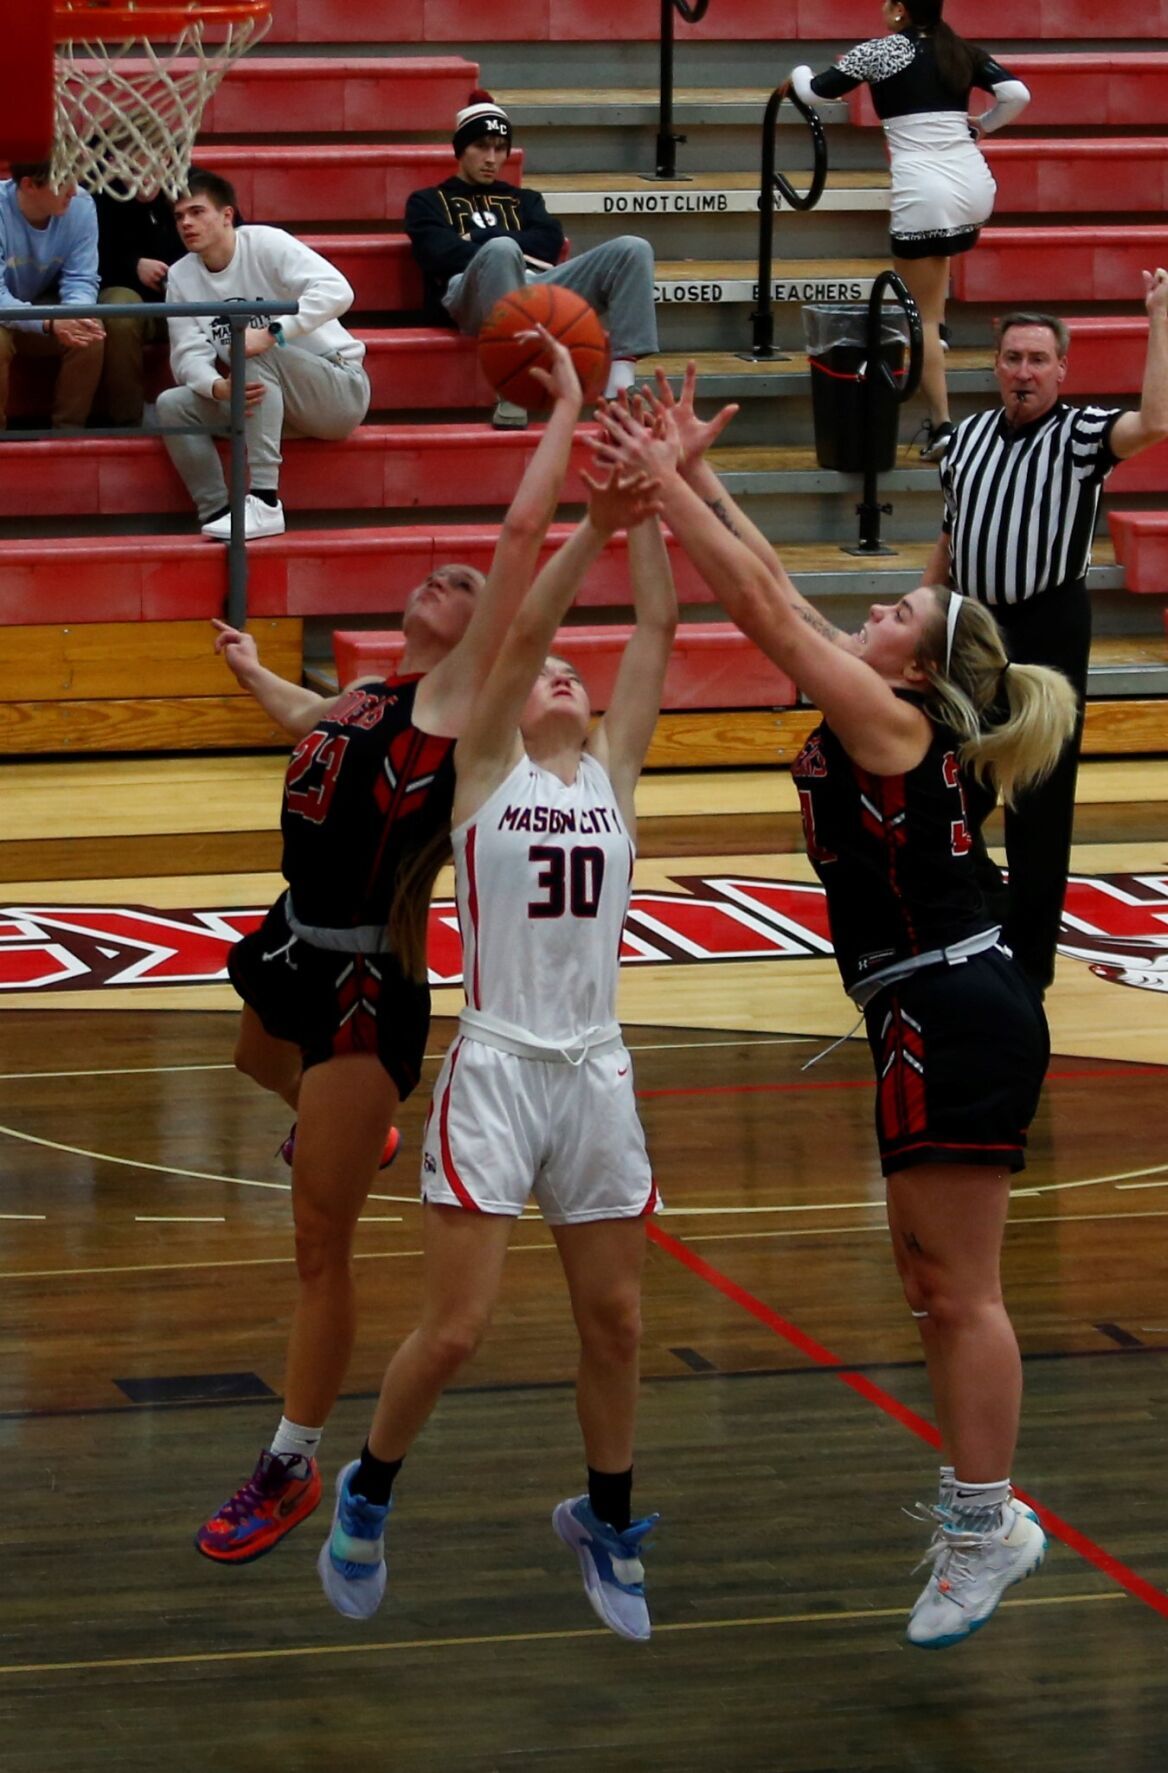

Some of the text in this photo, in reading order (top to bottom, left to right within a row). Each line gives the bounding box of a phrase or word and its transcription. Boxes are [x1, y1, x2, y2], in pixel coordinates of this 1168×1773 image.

[603, 196, 628, 212] DO
[633, 195, 667, 211] NOT
[674, 194, 728, 211] CLIMB
[498, 804, 577, 835] MASON
[528, 845, 606, 920] 30
